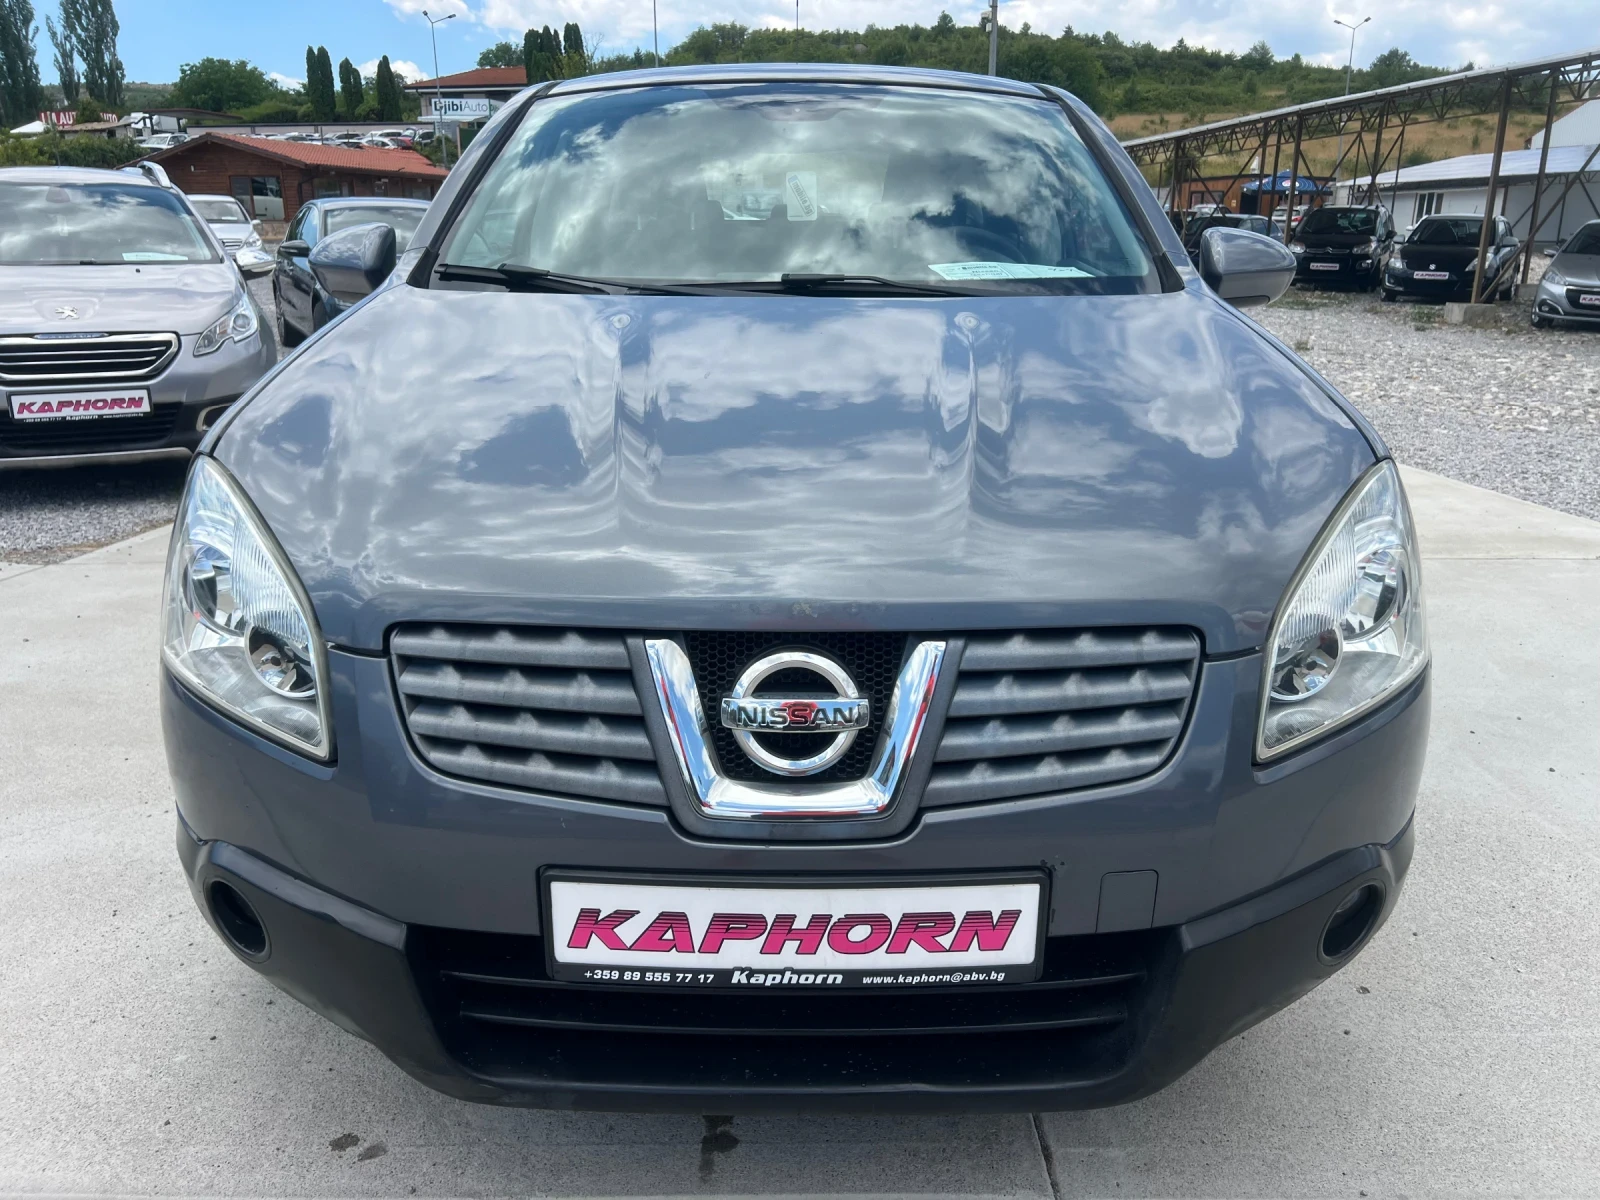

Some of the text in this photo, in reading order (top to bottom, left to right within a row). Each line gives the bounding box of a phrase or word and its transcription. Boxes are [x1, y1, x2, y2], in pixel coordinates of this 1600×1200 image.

[17, 397, 144, 414] KAPHORN
[737, 705, 856, 727] NISSAN
[567, 908, 1022, 954] KAPHORN
[584, 969, 1006, 986] +359 89 555 77 17 Kaphorn www.kaphorn@abv.bg
